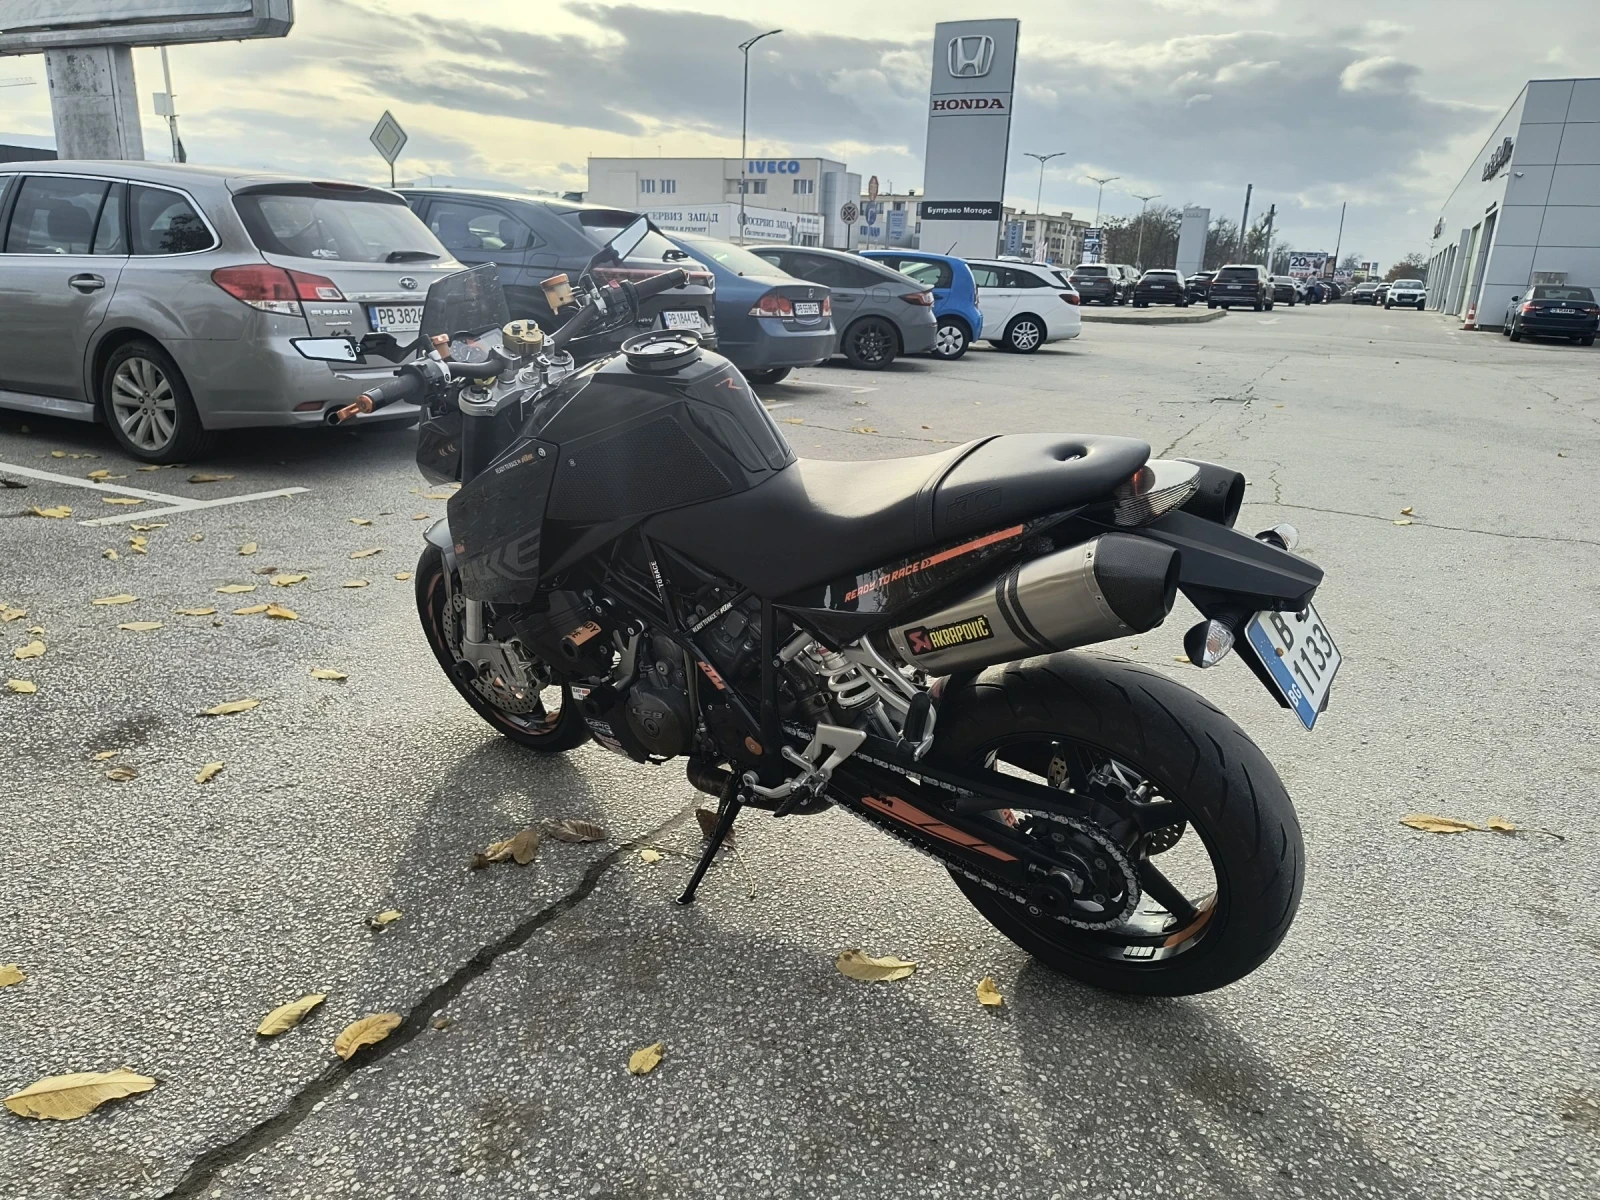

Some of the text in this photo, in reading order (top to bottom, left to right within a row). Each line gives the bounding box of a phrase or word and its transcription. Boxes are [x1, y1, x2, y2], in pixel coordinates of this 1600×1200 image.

[932, 98, 1005, 111] HONDA
[749, 160, 800, 174] IVECO
[637, 211, 719, 223] СЕРВИЗ ЗАПАД
[927, 206, 993, 216] Бултрако Моторс
[378, 307, 396, 325] PB
[667, 312, 678, 325] PB
[650, 560, 662, 579] RACE
[656, 578, 664, 588] TO
[844, 561, 920, 603] READY TO RACE
[929, 617, 989, 648] AKRAPOVIČ
[1269, 610, 1295, 651] B
[1293, 623, 1333, 695] 1133
[1287, 683, 1303, 708] BG
